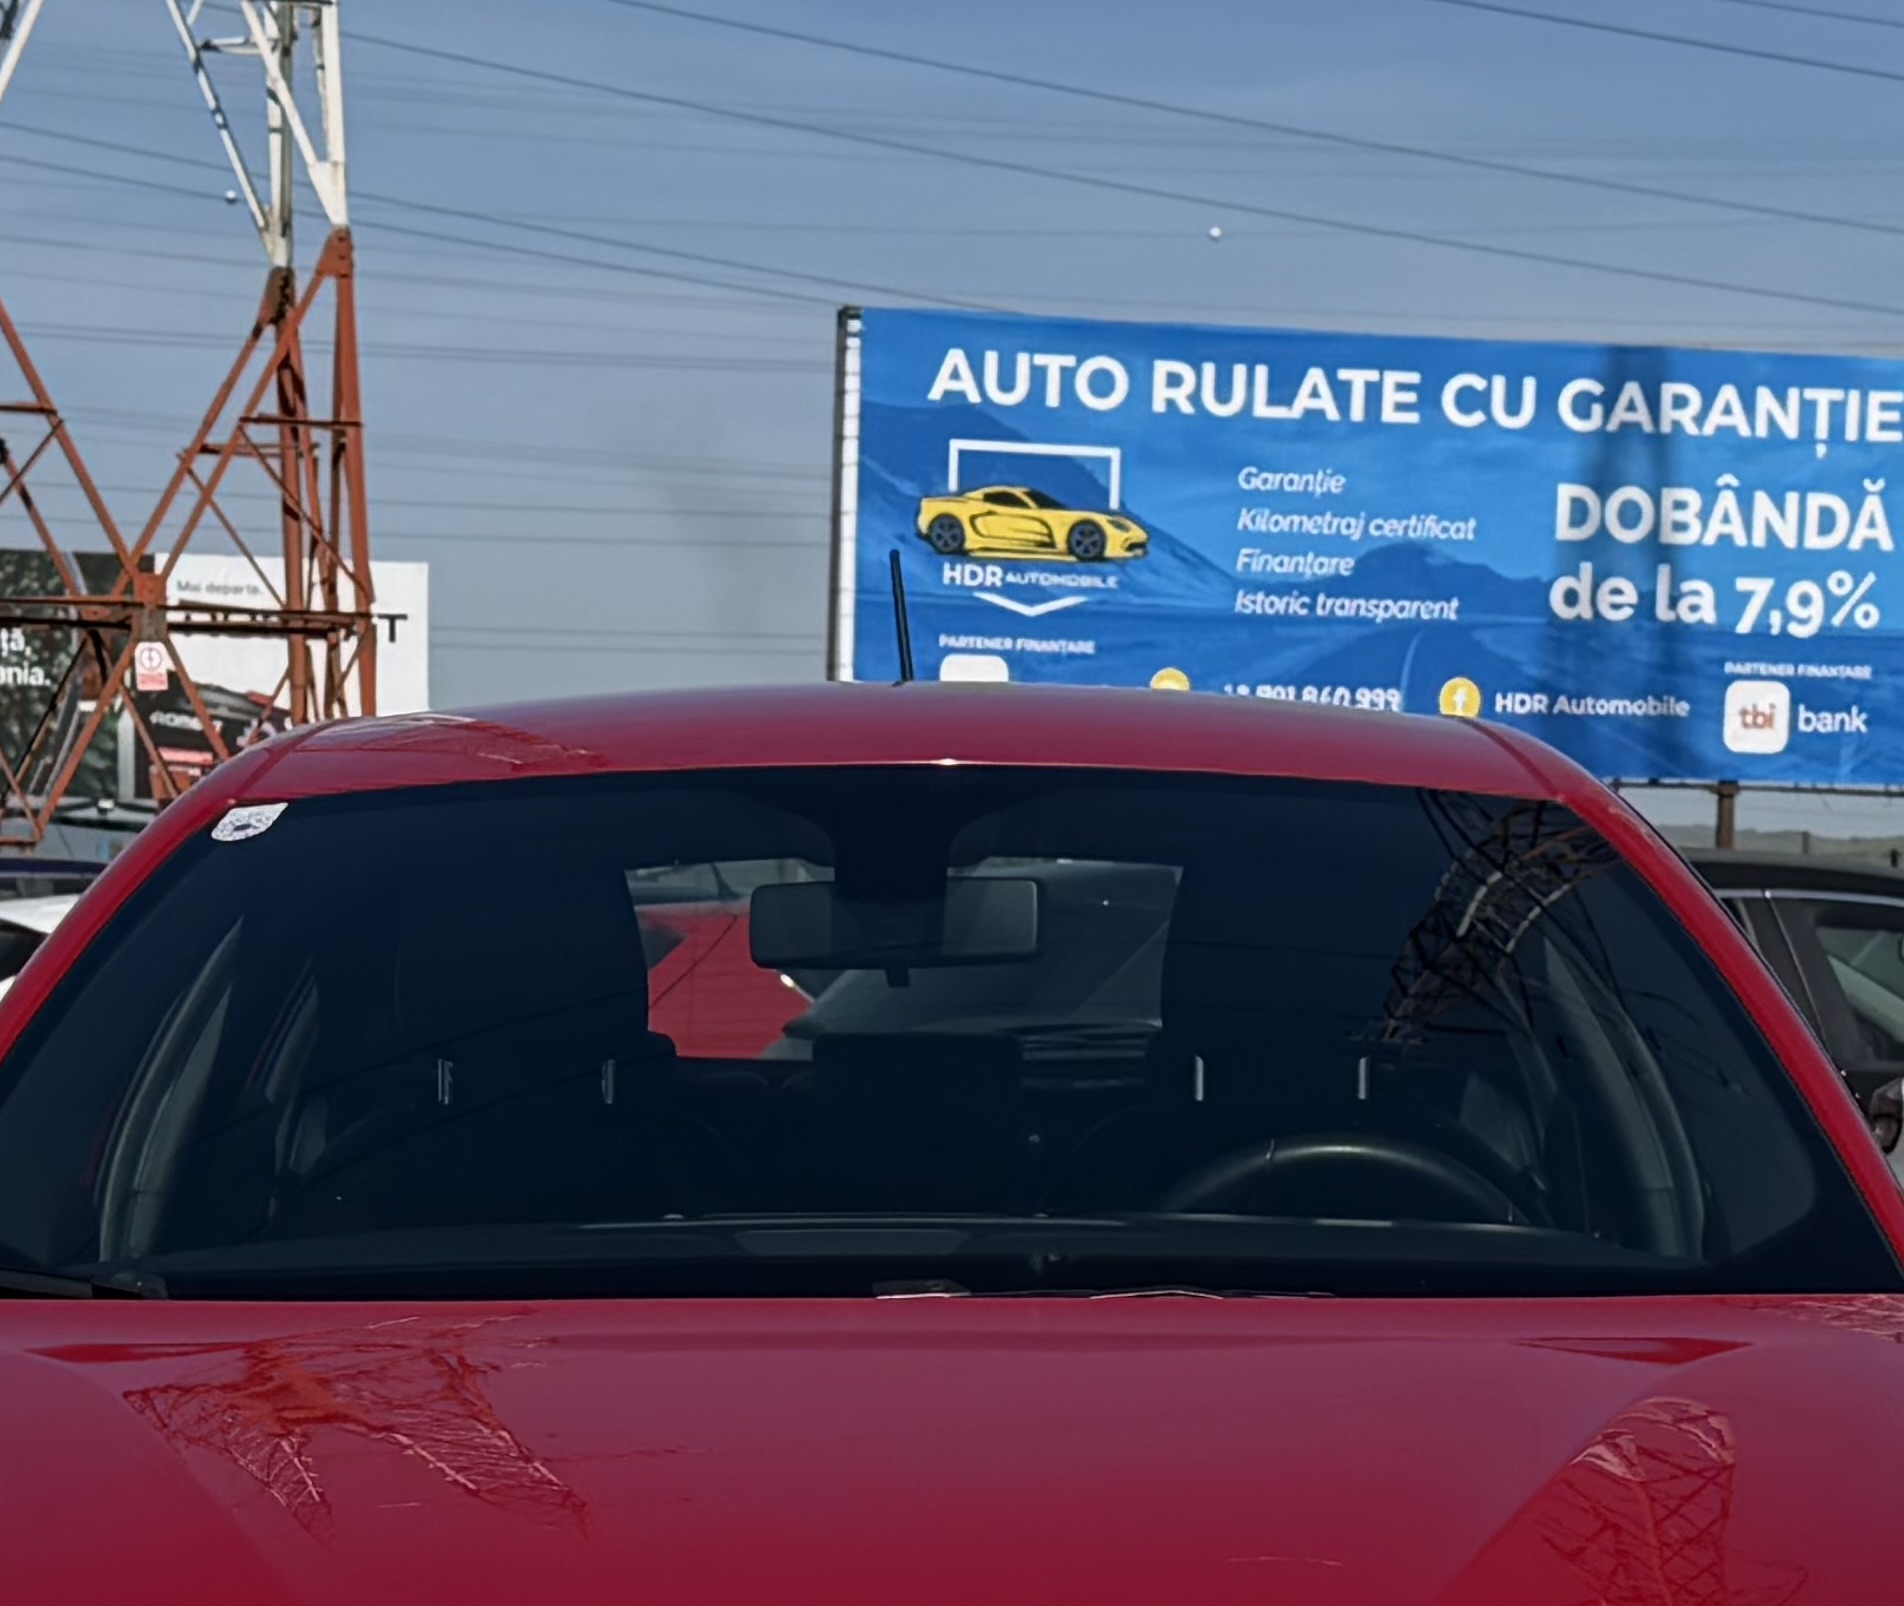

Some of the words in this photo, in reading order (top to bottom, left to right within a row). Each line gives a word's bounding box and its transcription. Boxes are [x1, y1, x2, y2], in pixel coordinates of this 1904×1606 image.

[927, 348, 1129, 411] AUTO
[1151, 359, 1422, 424] RULATE
[1441, 373, 1537, 429] CU
[1557, 378, 1904, 459] GARANȚIE
[1237, 507, 1366, 541] Kilometraj
[1368, 513, 1478, 541] certificat
[1555, 473, 1895, 552] DOBÂNDĂ
[943, 562, 1003, 588] HDR
[1005, 570, 1119, 589] AUTOMOBILE
[1234, 589, 1311, 616] Istoric
[1315, 592, 1460, 624] transparent
[1549, 561, 1639, 622] de
[1655, 563, 1717, 625] la
[1735, 570, 1880, 638] 7,9%
[1495, 692, 1547, 715] HDR
[1552, 694, 1691, 717] Automobile
[1739, 702, 1776, 729] tbi
[1797, 703, 1869, 734] bank
